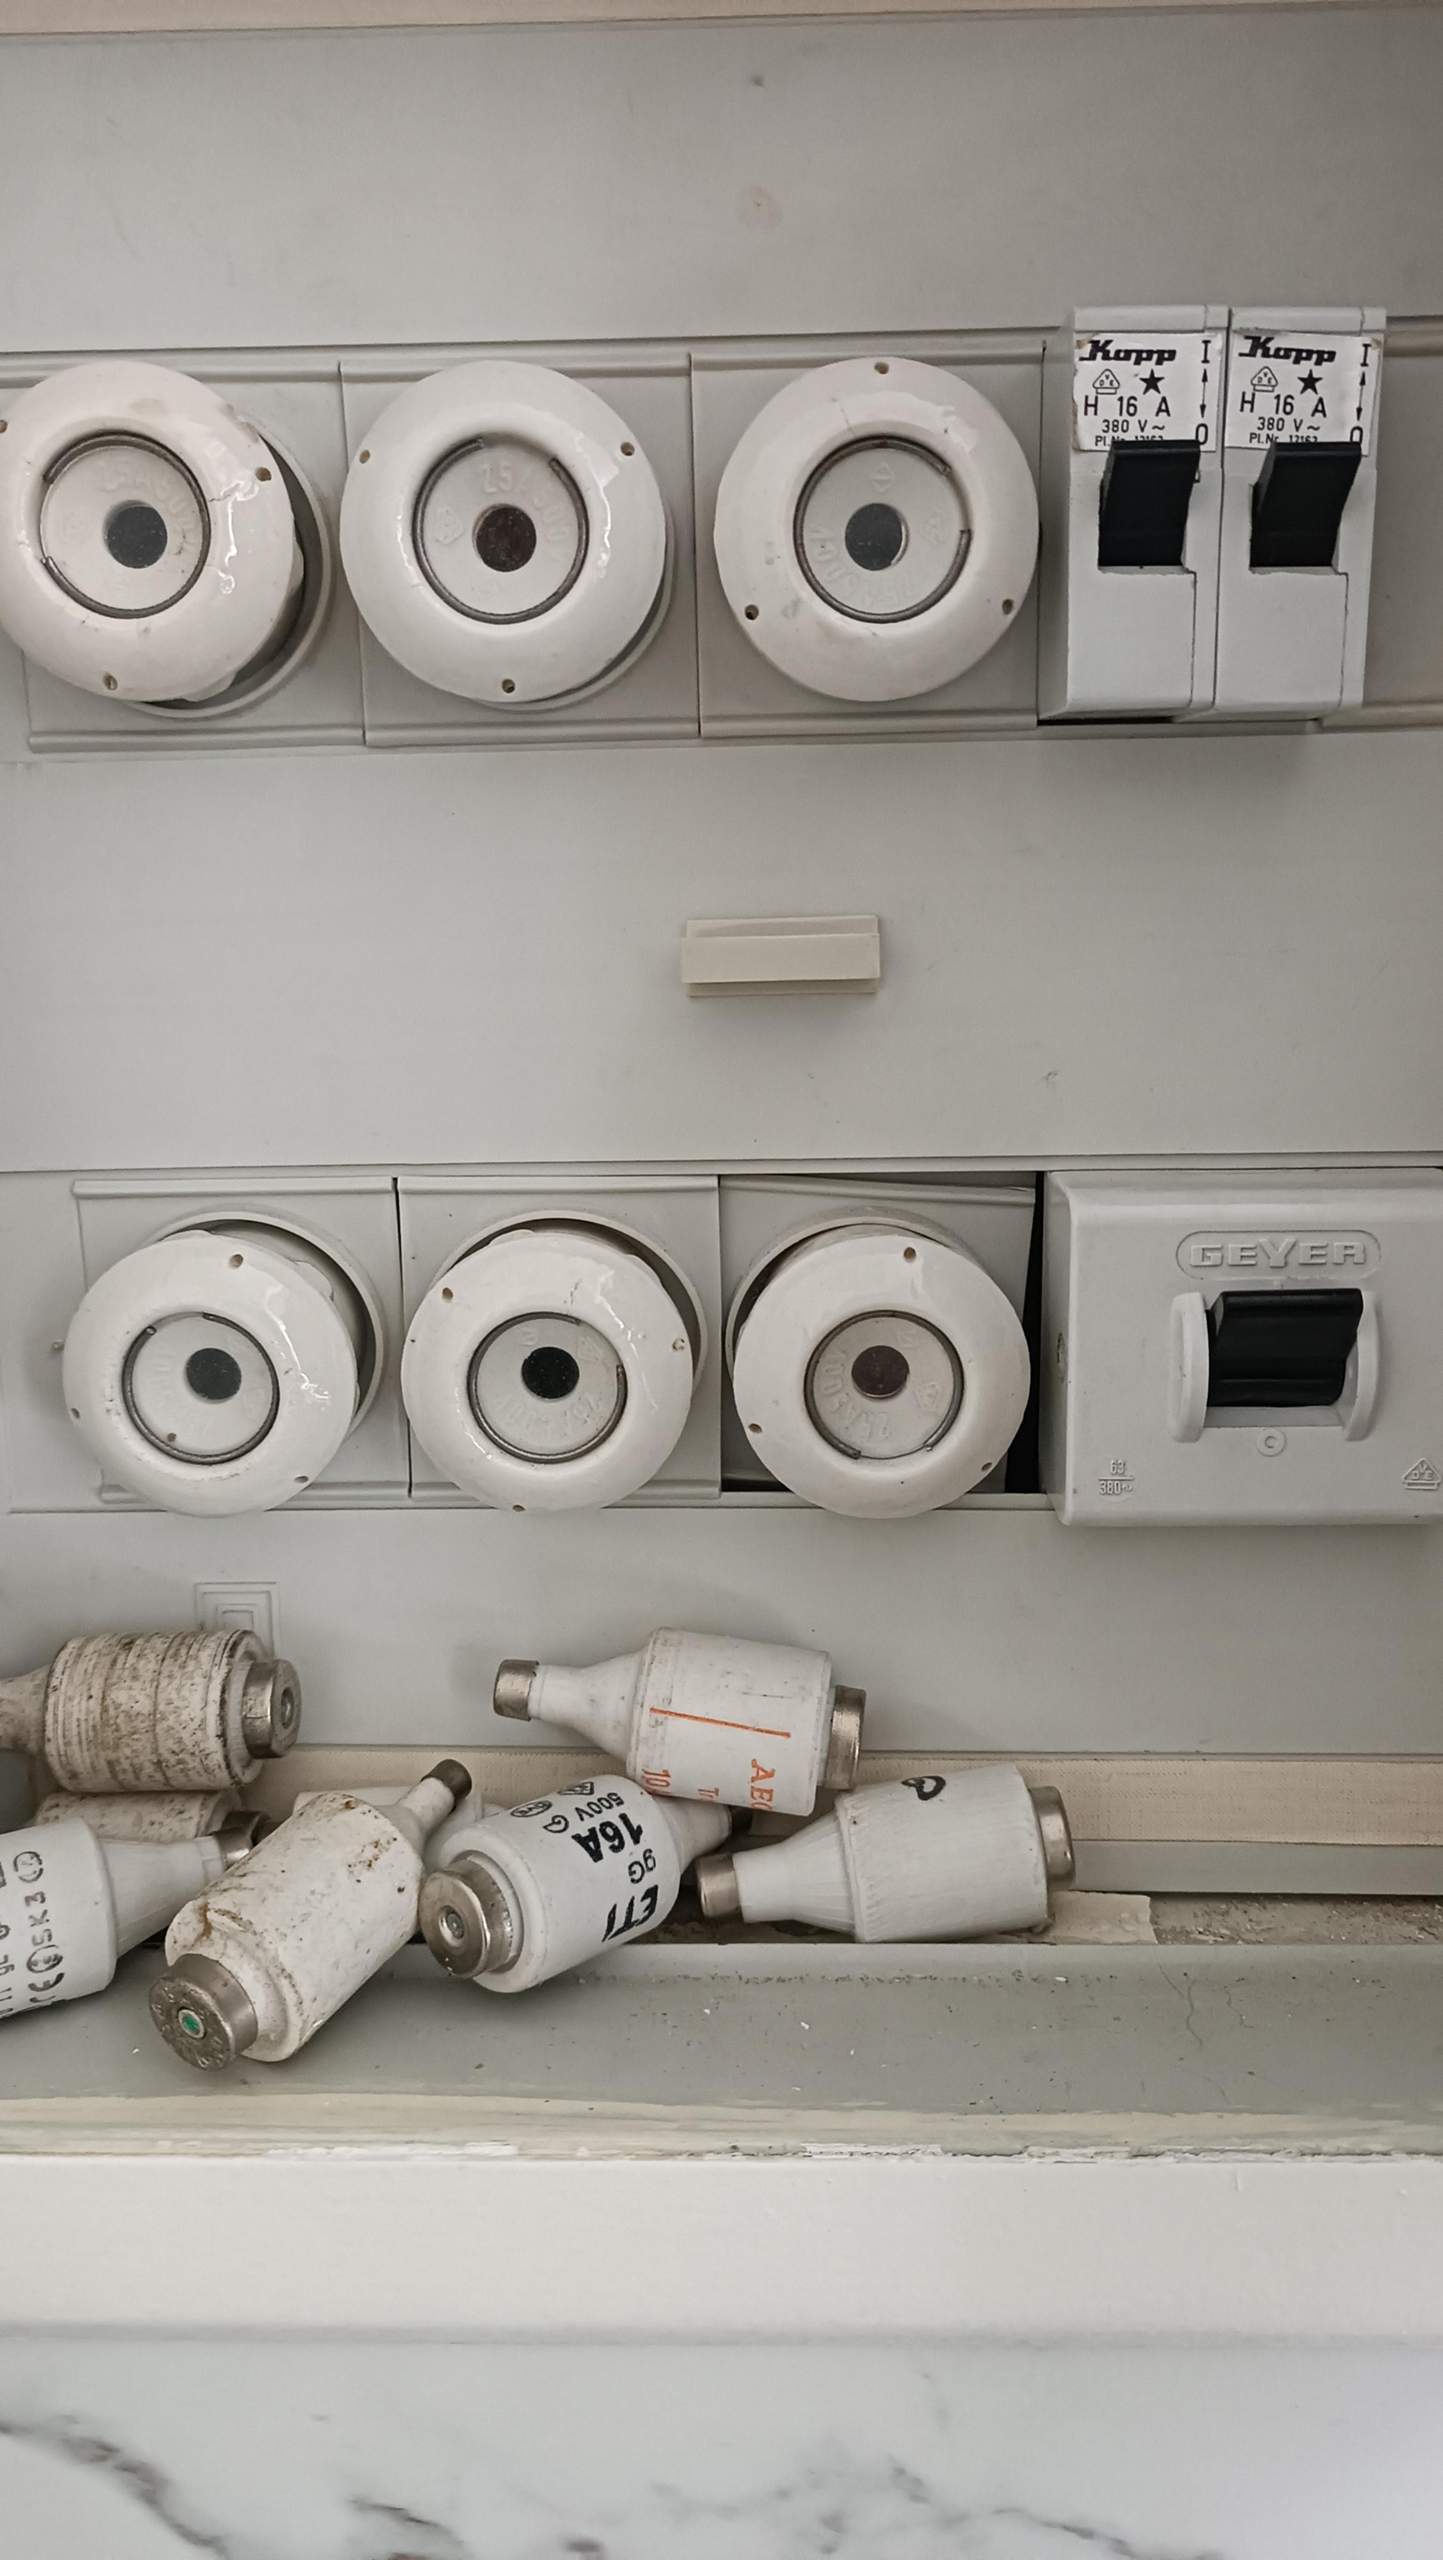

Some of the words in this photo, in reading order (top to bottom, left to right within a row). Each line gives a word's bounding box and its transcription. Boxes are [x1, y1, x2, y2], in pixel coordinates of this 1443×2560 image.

[1079, 339, 1176, 366] Kopp
[1238, 335, 1336, 366] Kopp
[1083, 395, 1098, 416] H
[1117, 395, 1138, 417] 16
[1155, 396, 1171, 417] A
[1240, 391, 1255, 413] H
[1274, 394, 1294, 416] 16
[1311, 396, 1327, 418] A
[1102, 419, 1129, 433] 380
[1257, 416, 1285, 431] 380
[1190, 1237, 1367, 1269] GEYER
[1110, 1459, 1125, 1475] 63
[574, 1792, 625, 1822] 500V
[571, 1812, 643, 1863] 16A
[627, 1848, 656, 1884] gG
[601, 1884, 658, 1943] ETI
